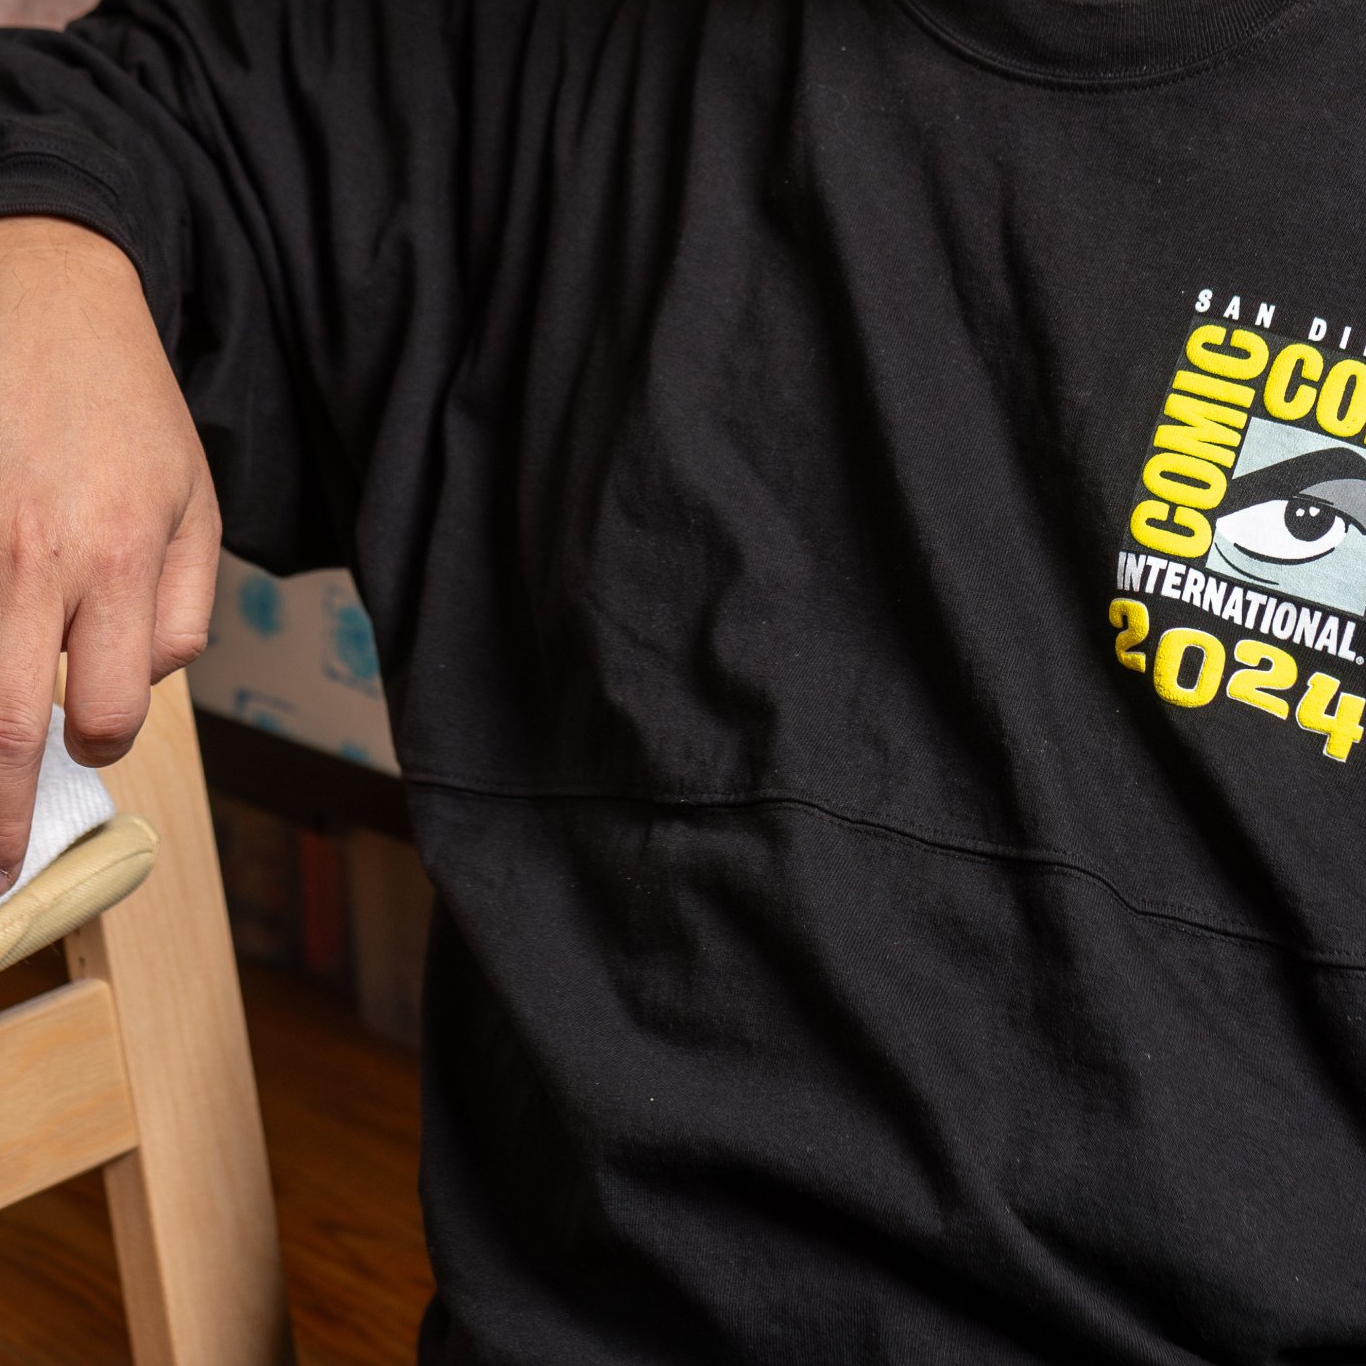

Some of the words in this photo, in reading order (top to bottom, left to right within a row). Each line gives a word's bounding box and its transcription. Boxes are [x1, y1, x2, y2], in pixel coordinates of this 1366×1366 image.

[1195, 288, 1276, 330] SAN
[1129, 323, 1270, 560] COMIC
[1108, 596, 1366, 763] 2024
